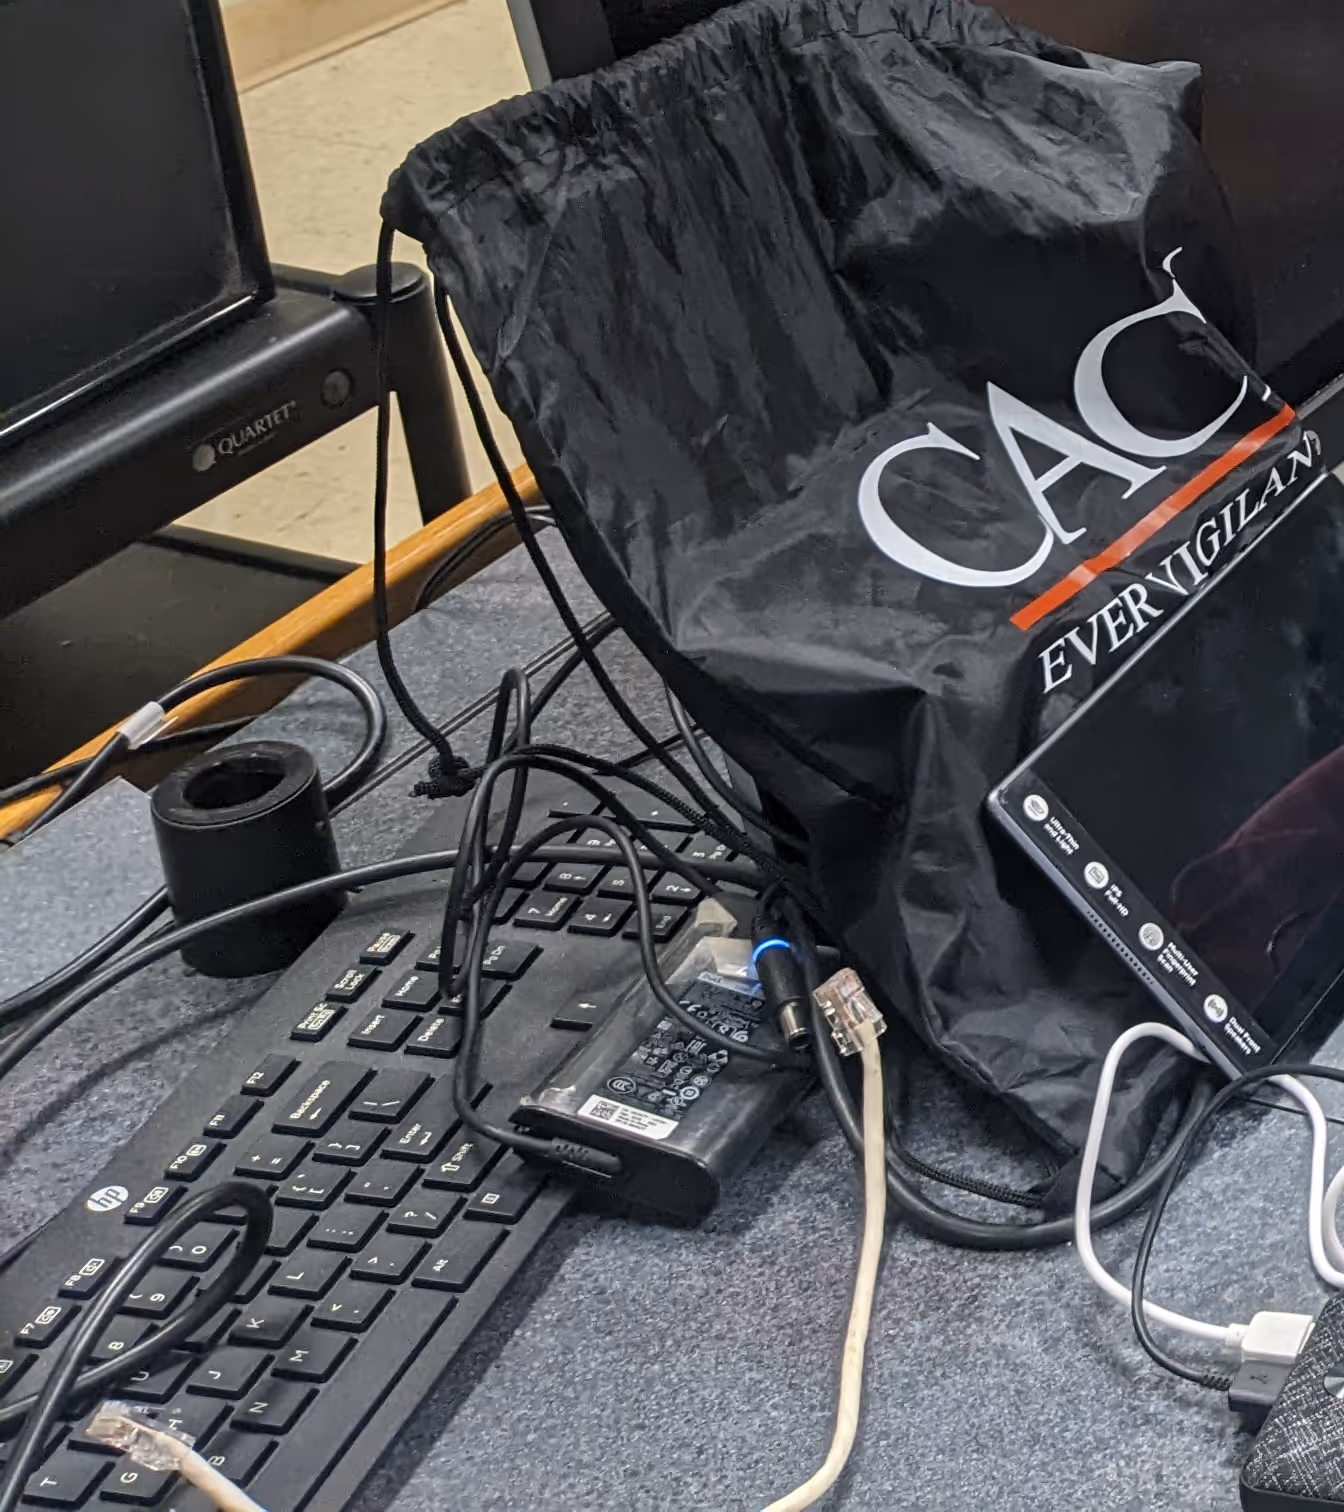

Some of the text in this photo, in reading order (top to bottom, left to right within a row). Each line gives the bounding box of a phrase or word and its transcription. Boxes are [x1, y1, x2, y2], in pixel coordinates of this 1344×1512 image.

[857, 246, 1272, 588] CAC
[218, 401, 292, 455] QUARTET
[1037, 583, 1165, 694] EVER
[1043, 823, 1074, 856] and Light
[1049, 816, 1080, 850] Ultra-Thin
[559, 872, 572, 880] 8
[666, 884, 679, 892] 2
[1110, 883, 1123, 898] IPS
[1104, 889, 1129, 917] Full-HD
[1157, 954, 1174, 973] Scan
[1162, 948, 1197, 987] Fingerprint
[1167, 942, 1199, 976] Multi-User
[335, 969, 358, 990] Scroll
[345, 972, 366, 991] Lock
[395, 975, 420, 997] Home
[298, 1008, 318, 1030] Print
[361, 1014, 385, 1035] Insert
[418, 1018, 445, 1042] Delete
[1224, 1023, 1252, 1055] Speakers
[1229, 1016, 1261, 1053] Dual Front
[246, 1071, 265, 1085] F12
[289, 1080, 331, 1121] Backspace
[209, 1114, 225, 1126] F11
[399, 1123, 422, 1144] Enter
[452, 1142, 474, 1162] Shift
[170, 1155, 188, 1170] F10
[86, 1185, 129, 1212] hp
[129, 1202, 146, 1215] F9
[432, 1259, 449, 1272] Alt
[65, 1275, 81, 1287] F8
[150, 1292, 166, 1302] 9
[20, 1323, 35, 1336] F7
[247, 1317, 265, 1329] K
[108, 1341, 124, 1351] 8
[289, 1349, 309, 1363] M
[208, 1370, 222, 1380] J
[249, 1401, 269, 1414] N
[40, 1477, 58, 1487] T
[120, 1472, 139, 1484] G
